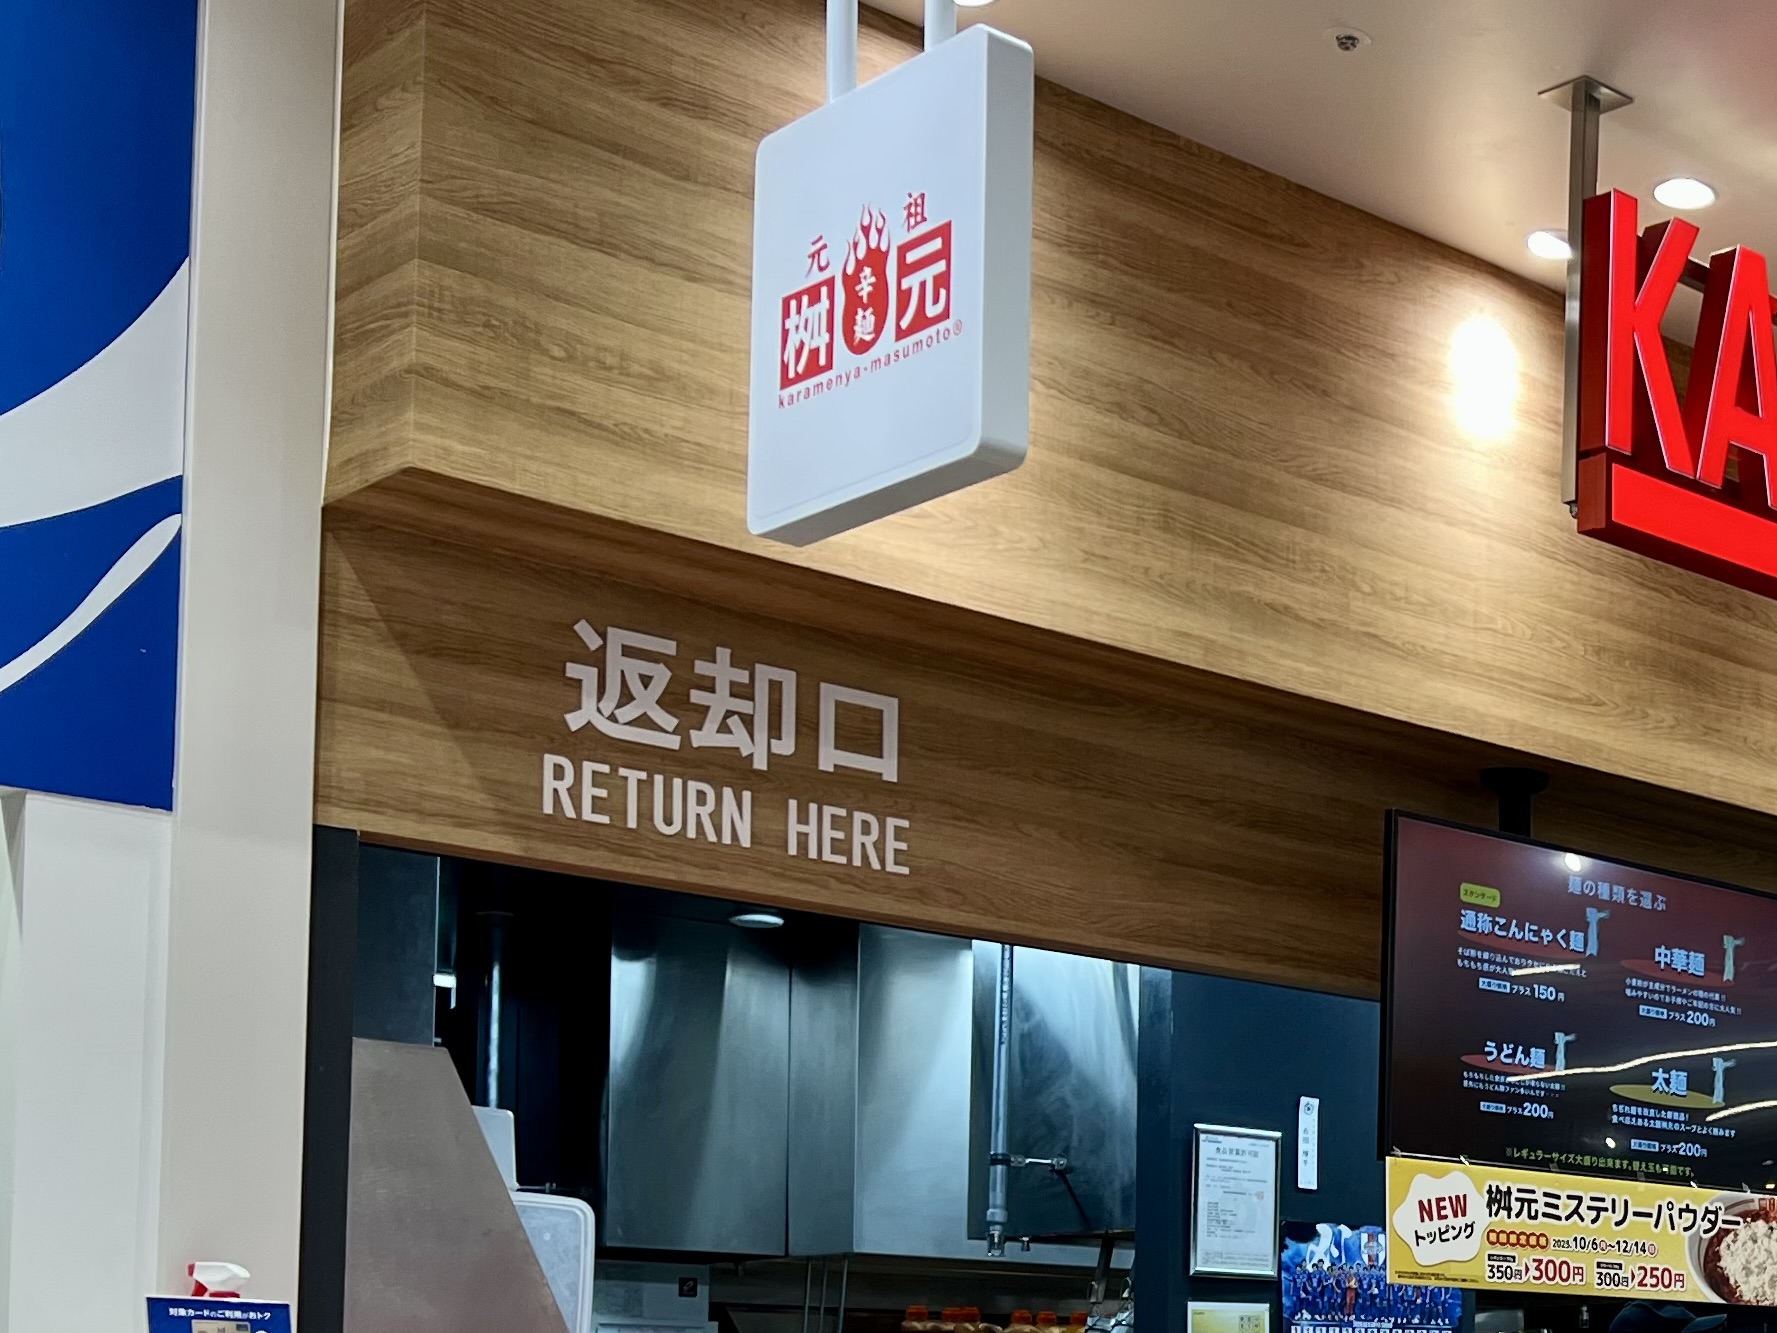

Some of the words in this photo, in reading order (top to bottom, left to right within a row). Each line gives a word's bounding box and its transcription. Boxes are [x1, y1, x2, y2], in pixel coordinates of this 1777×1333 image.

[564, 619, 899, 783] 返却口
[543, 753, 752, 849] RETURN
[787, 798, 910, 875] HERE
[1567, 875, 1667, 911] 麺の種類を選ぶ
[1460, 909, 1585, 953] 通称こんにゃく麺
[1654, 945, 1705, 977] 中華麺
[1484, 1040, 1546, 1069] うどん麺
[1651, 1068, 1689, 1097] 太麺
[1418, 1193, 1468, 1223] NEW
[1486, 1183, 1742, 1235] 桝元ミステリーパウダー
[1414, 1220, 1476, 1248] トッピング
[1487, 1264, 1523, 1281] 350円
[1532, 1258, 1585, 1284] 300円
[1596, 1271, 1630, 1290] 300円
[1637, 1265, 1686, 1290] 250円
